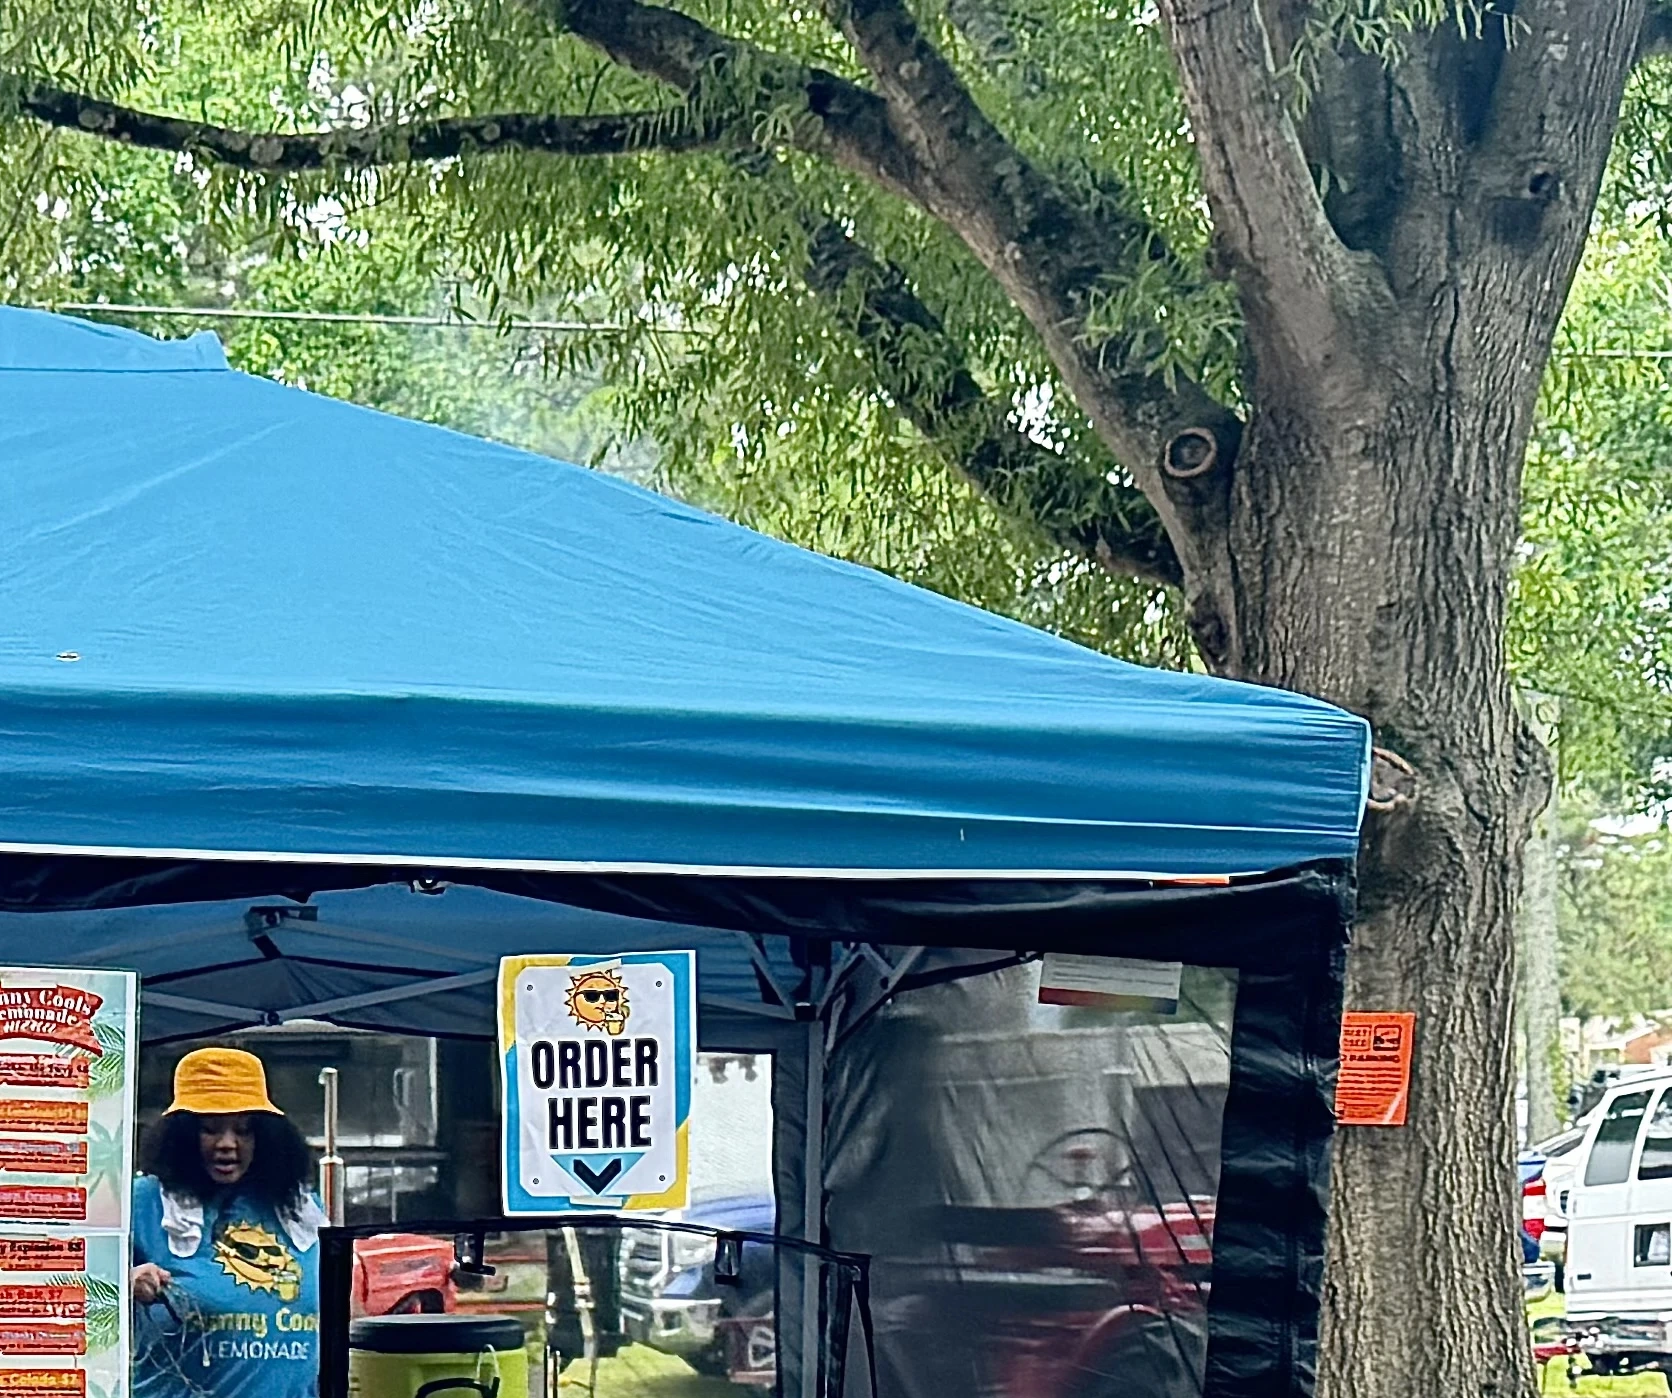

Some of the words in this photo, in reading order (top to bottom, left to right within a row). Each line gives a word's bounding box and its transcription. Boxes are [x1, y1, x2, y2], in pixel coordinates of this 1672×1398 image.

[39, 989, 92, 1015] Cools
[531, 1038, 659, 1090] ORDER
[548, 1095, 652, 1149] HERE
[208, 1340, 309, 1360] LEMONADE
